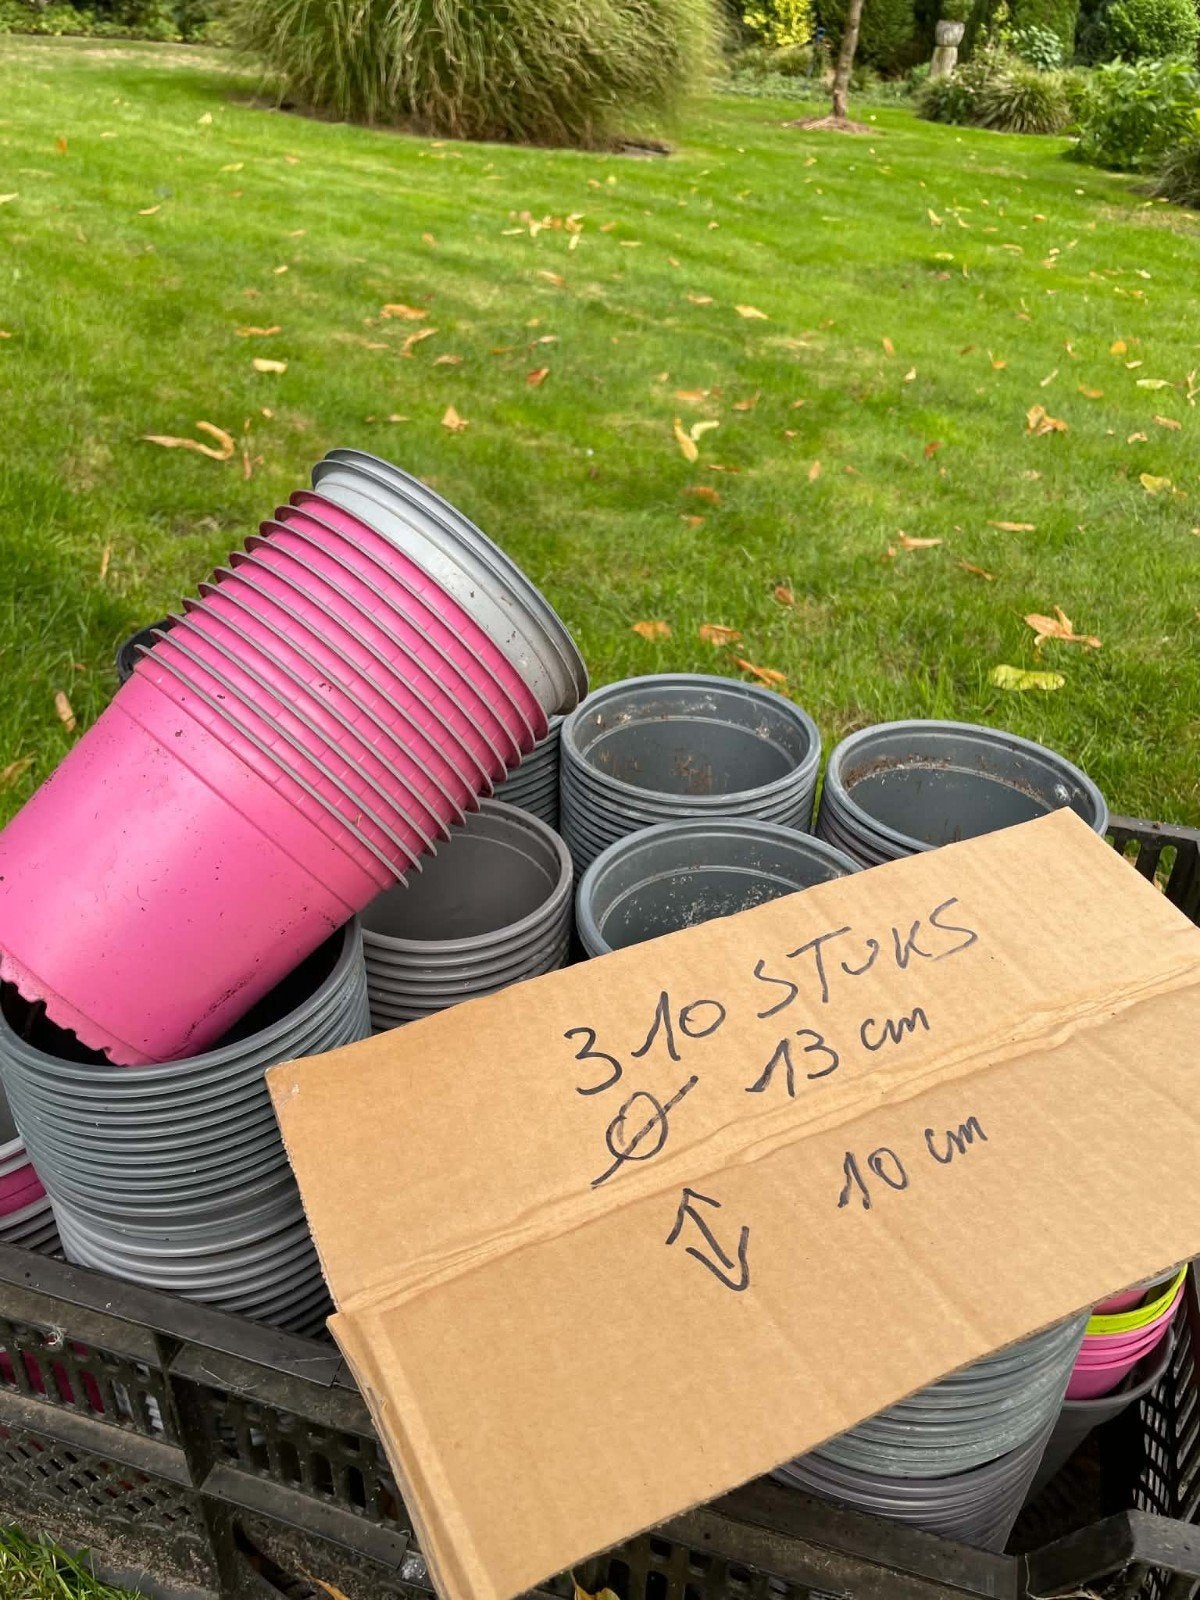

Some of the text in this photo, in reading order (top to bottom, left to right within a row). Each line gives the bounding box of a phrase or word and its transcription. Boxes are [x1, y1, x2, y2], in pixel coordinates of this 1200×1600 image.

[563, 897, 979, 1096] 310 STUKS
[745, 1028, 840, 1099] 13
[859, 1006, 931, 1052] cm
[836, 1115, 989, 1211] 10 cm
